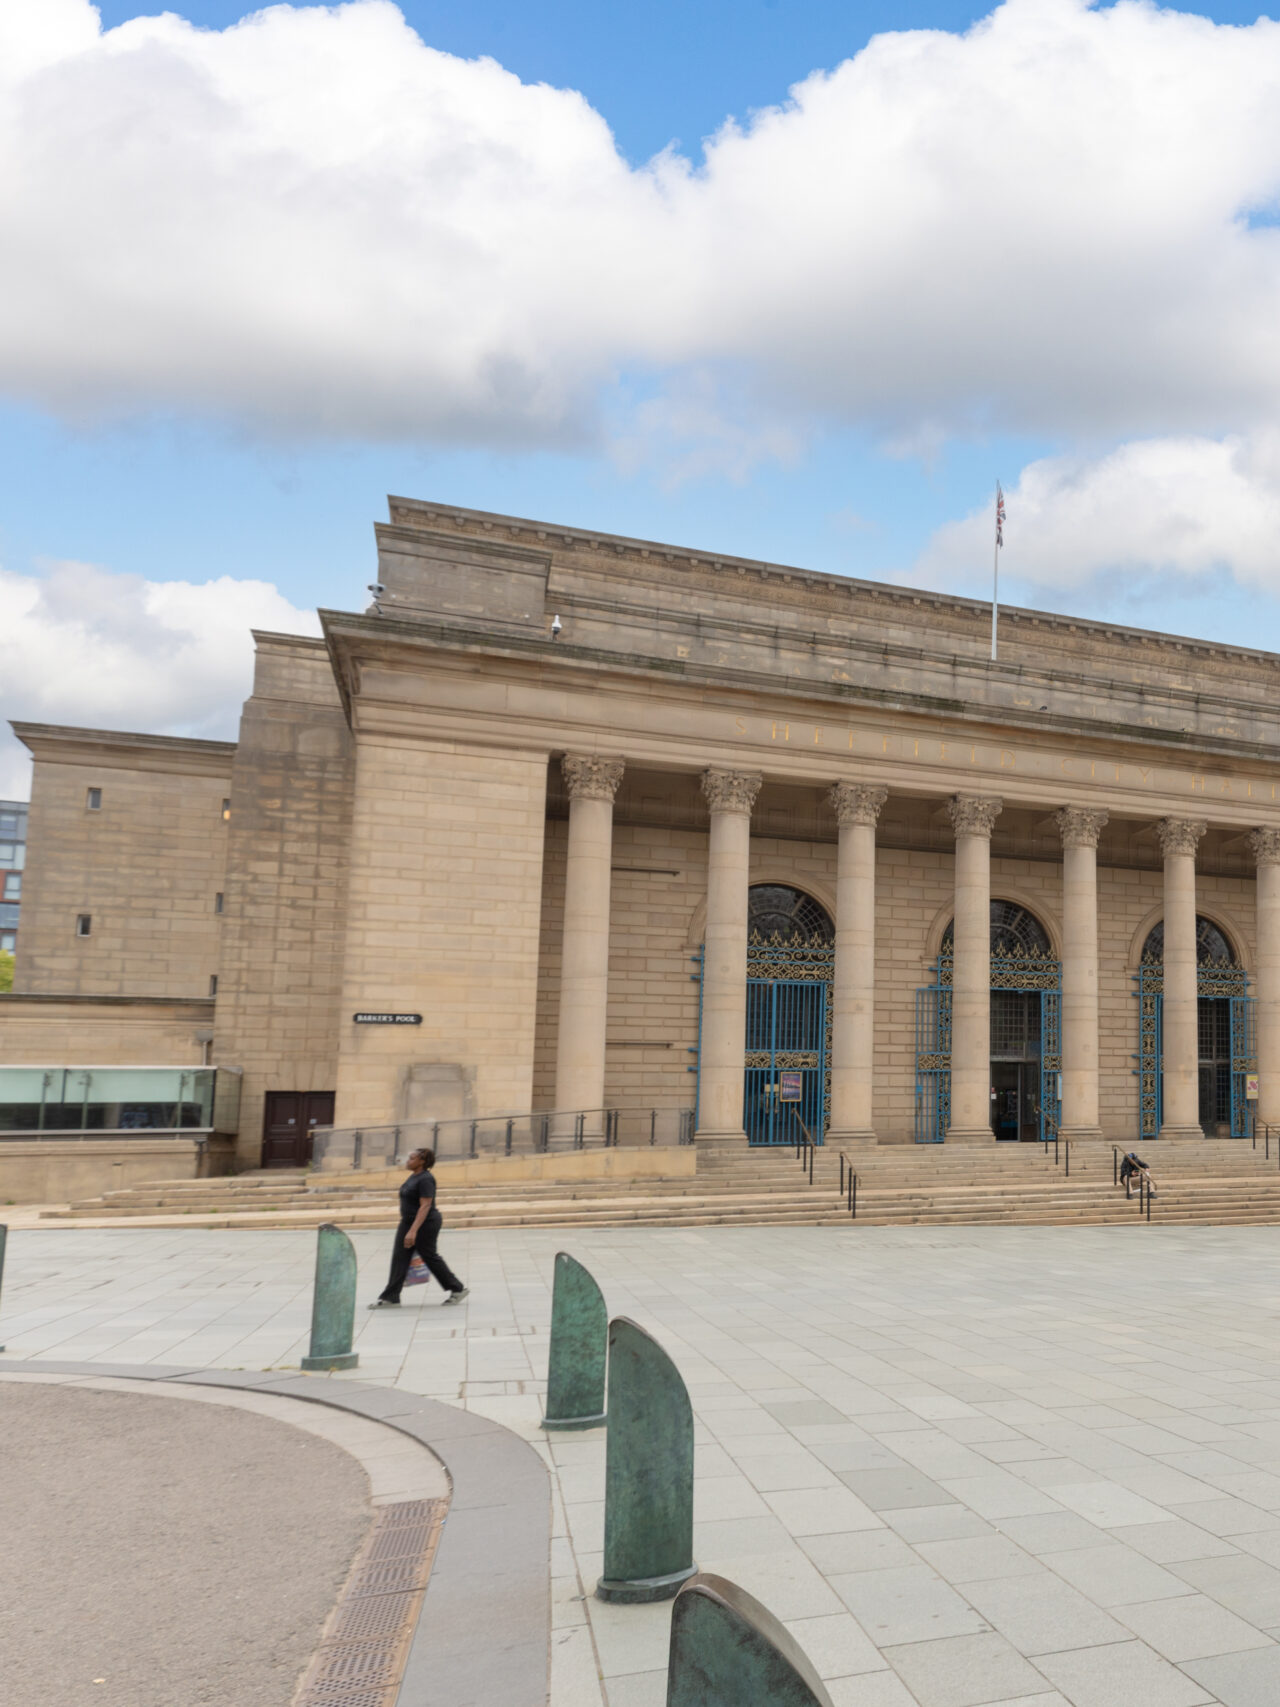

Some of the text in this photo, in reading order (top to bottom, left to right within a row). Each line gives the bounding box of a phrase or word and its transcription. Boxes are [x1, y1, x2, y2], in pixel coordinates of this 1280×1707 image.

[735, 716, 1280, 801] SHEFFIELD CITY HALL
[395, 1015, 415, 1023] POOL
